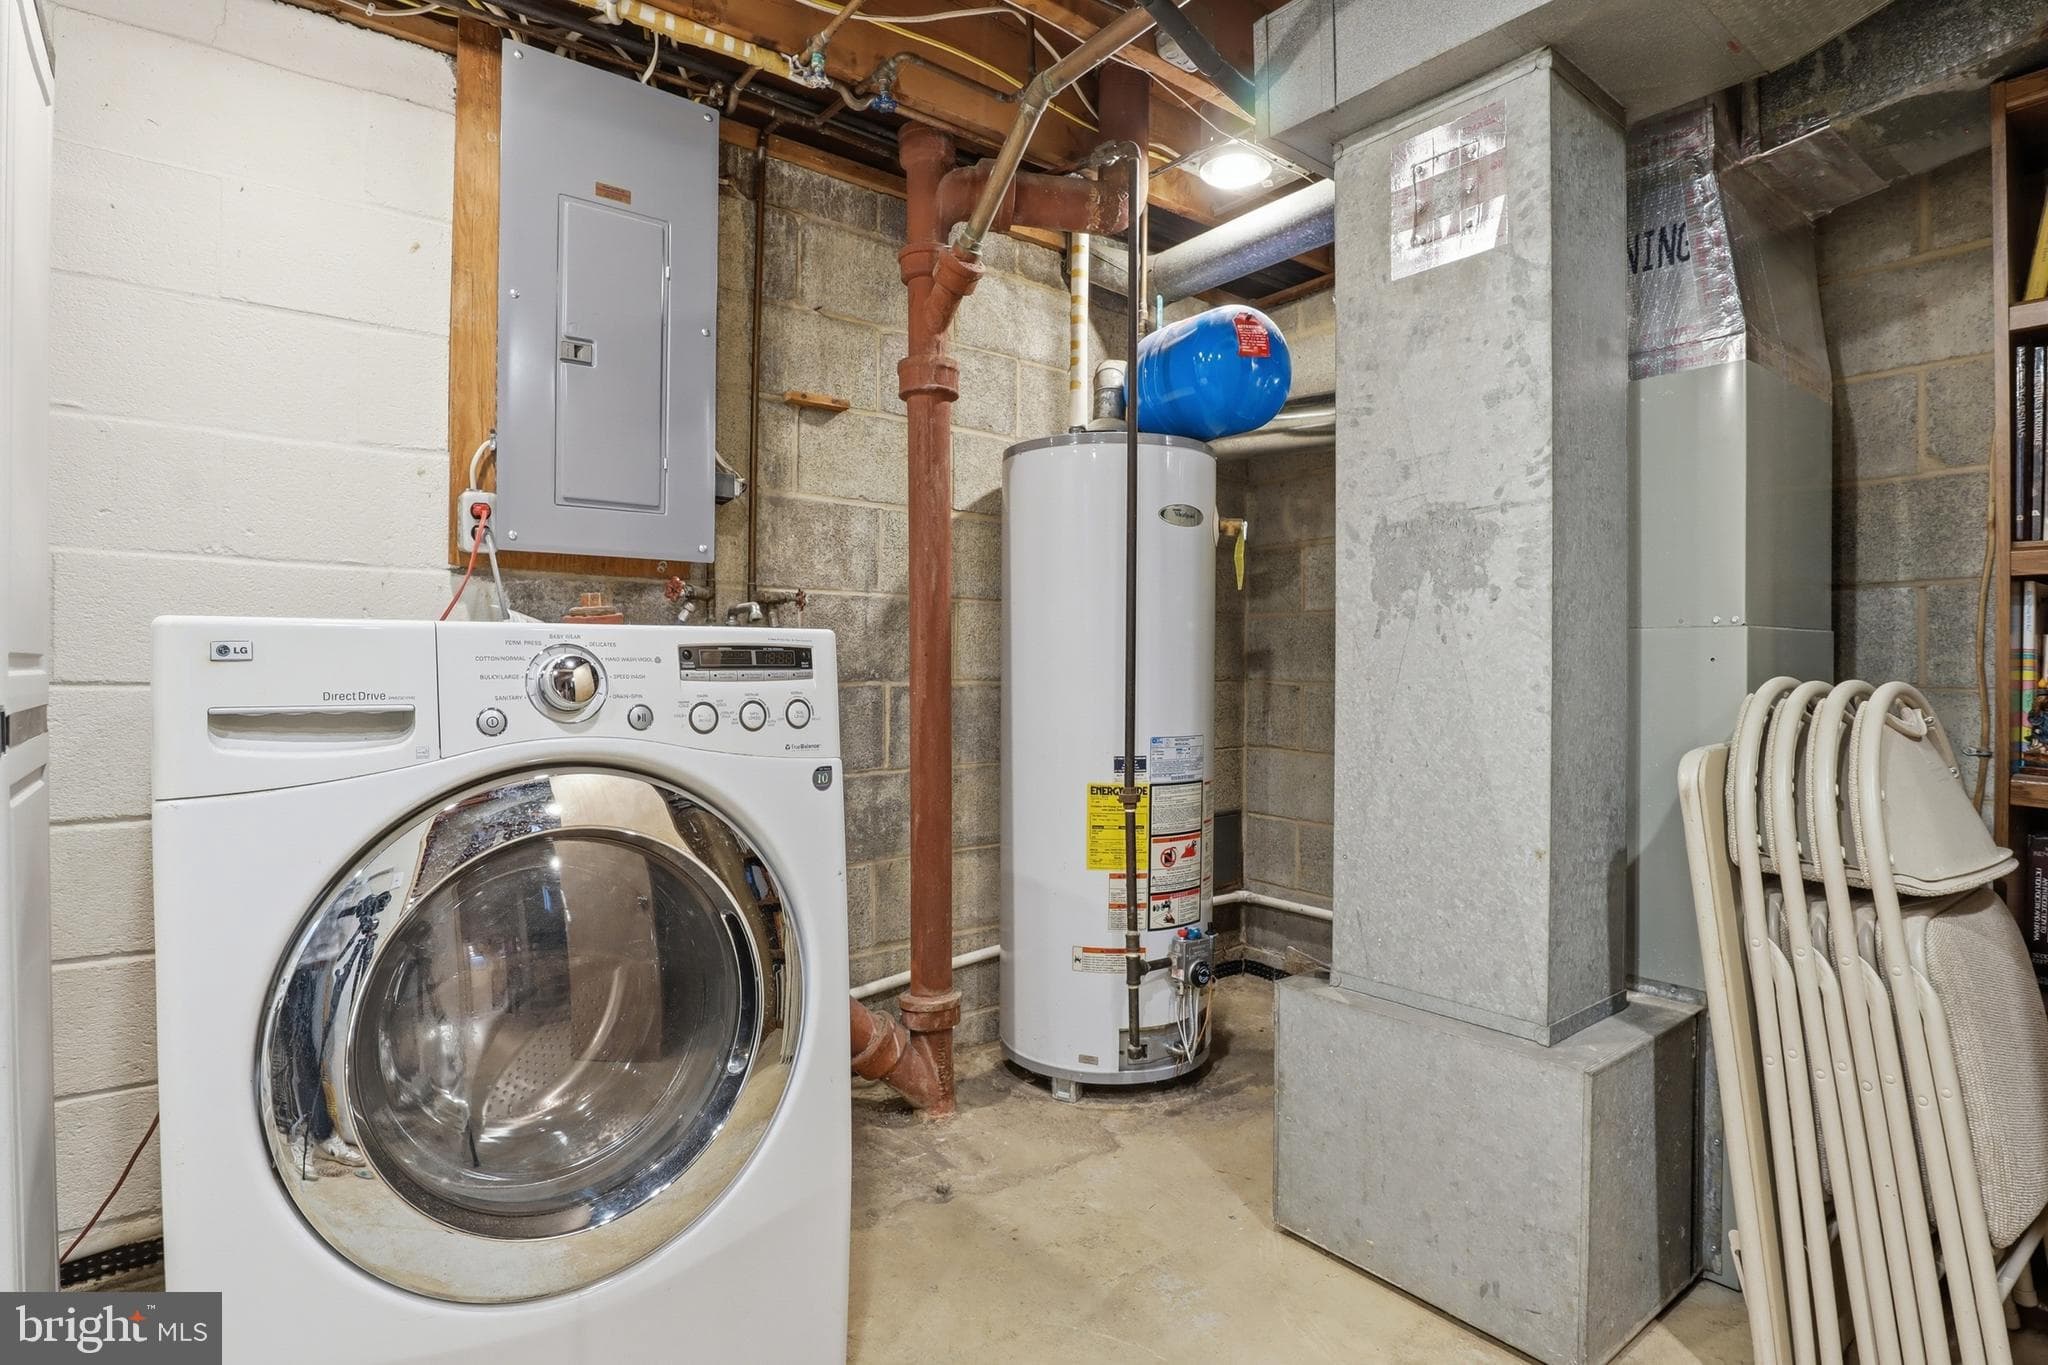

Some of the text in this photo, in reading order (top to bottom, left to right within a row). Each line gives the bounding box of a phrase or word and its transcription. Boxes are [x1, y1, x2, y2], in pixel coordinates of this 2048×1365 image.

[233, 646, 248, 655] LG
[322, 691, 357, 701] Direct
[358, 691, 386, 701] Drive
[817, 772, 829, 784] 10
